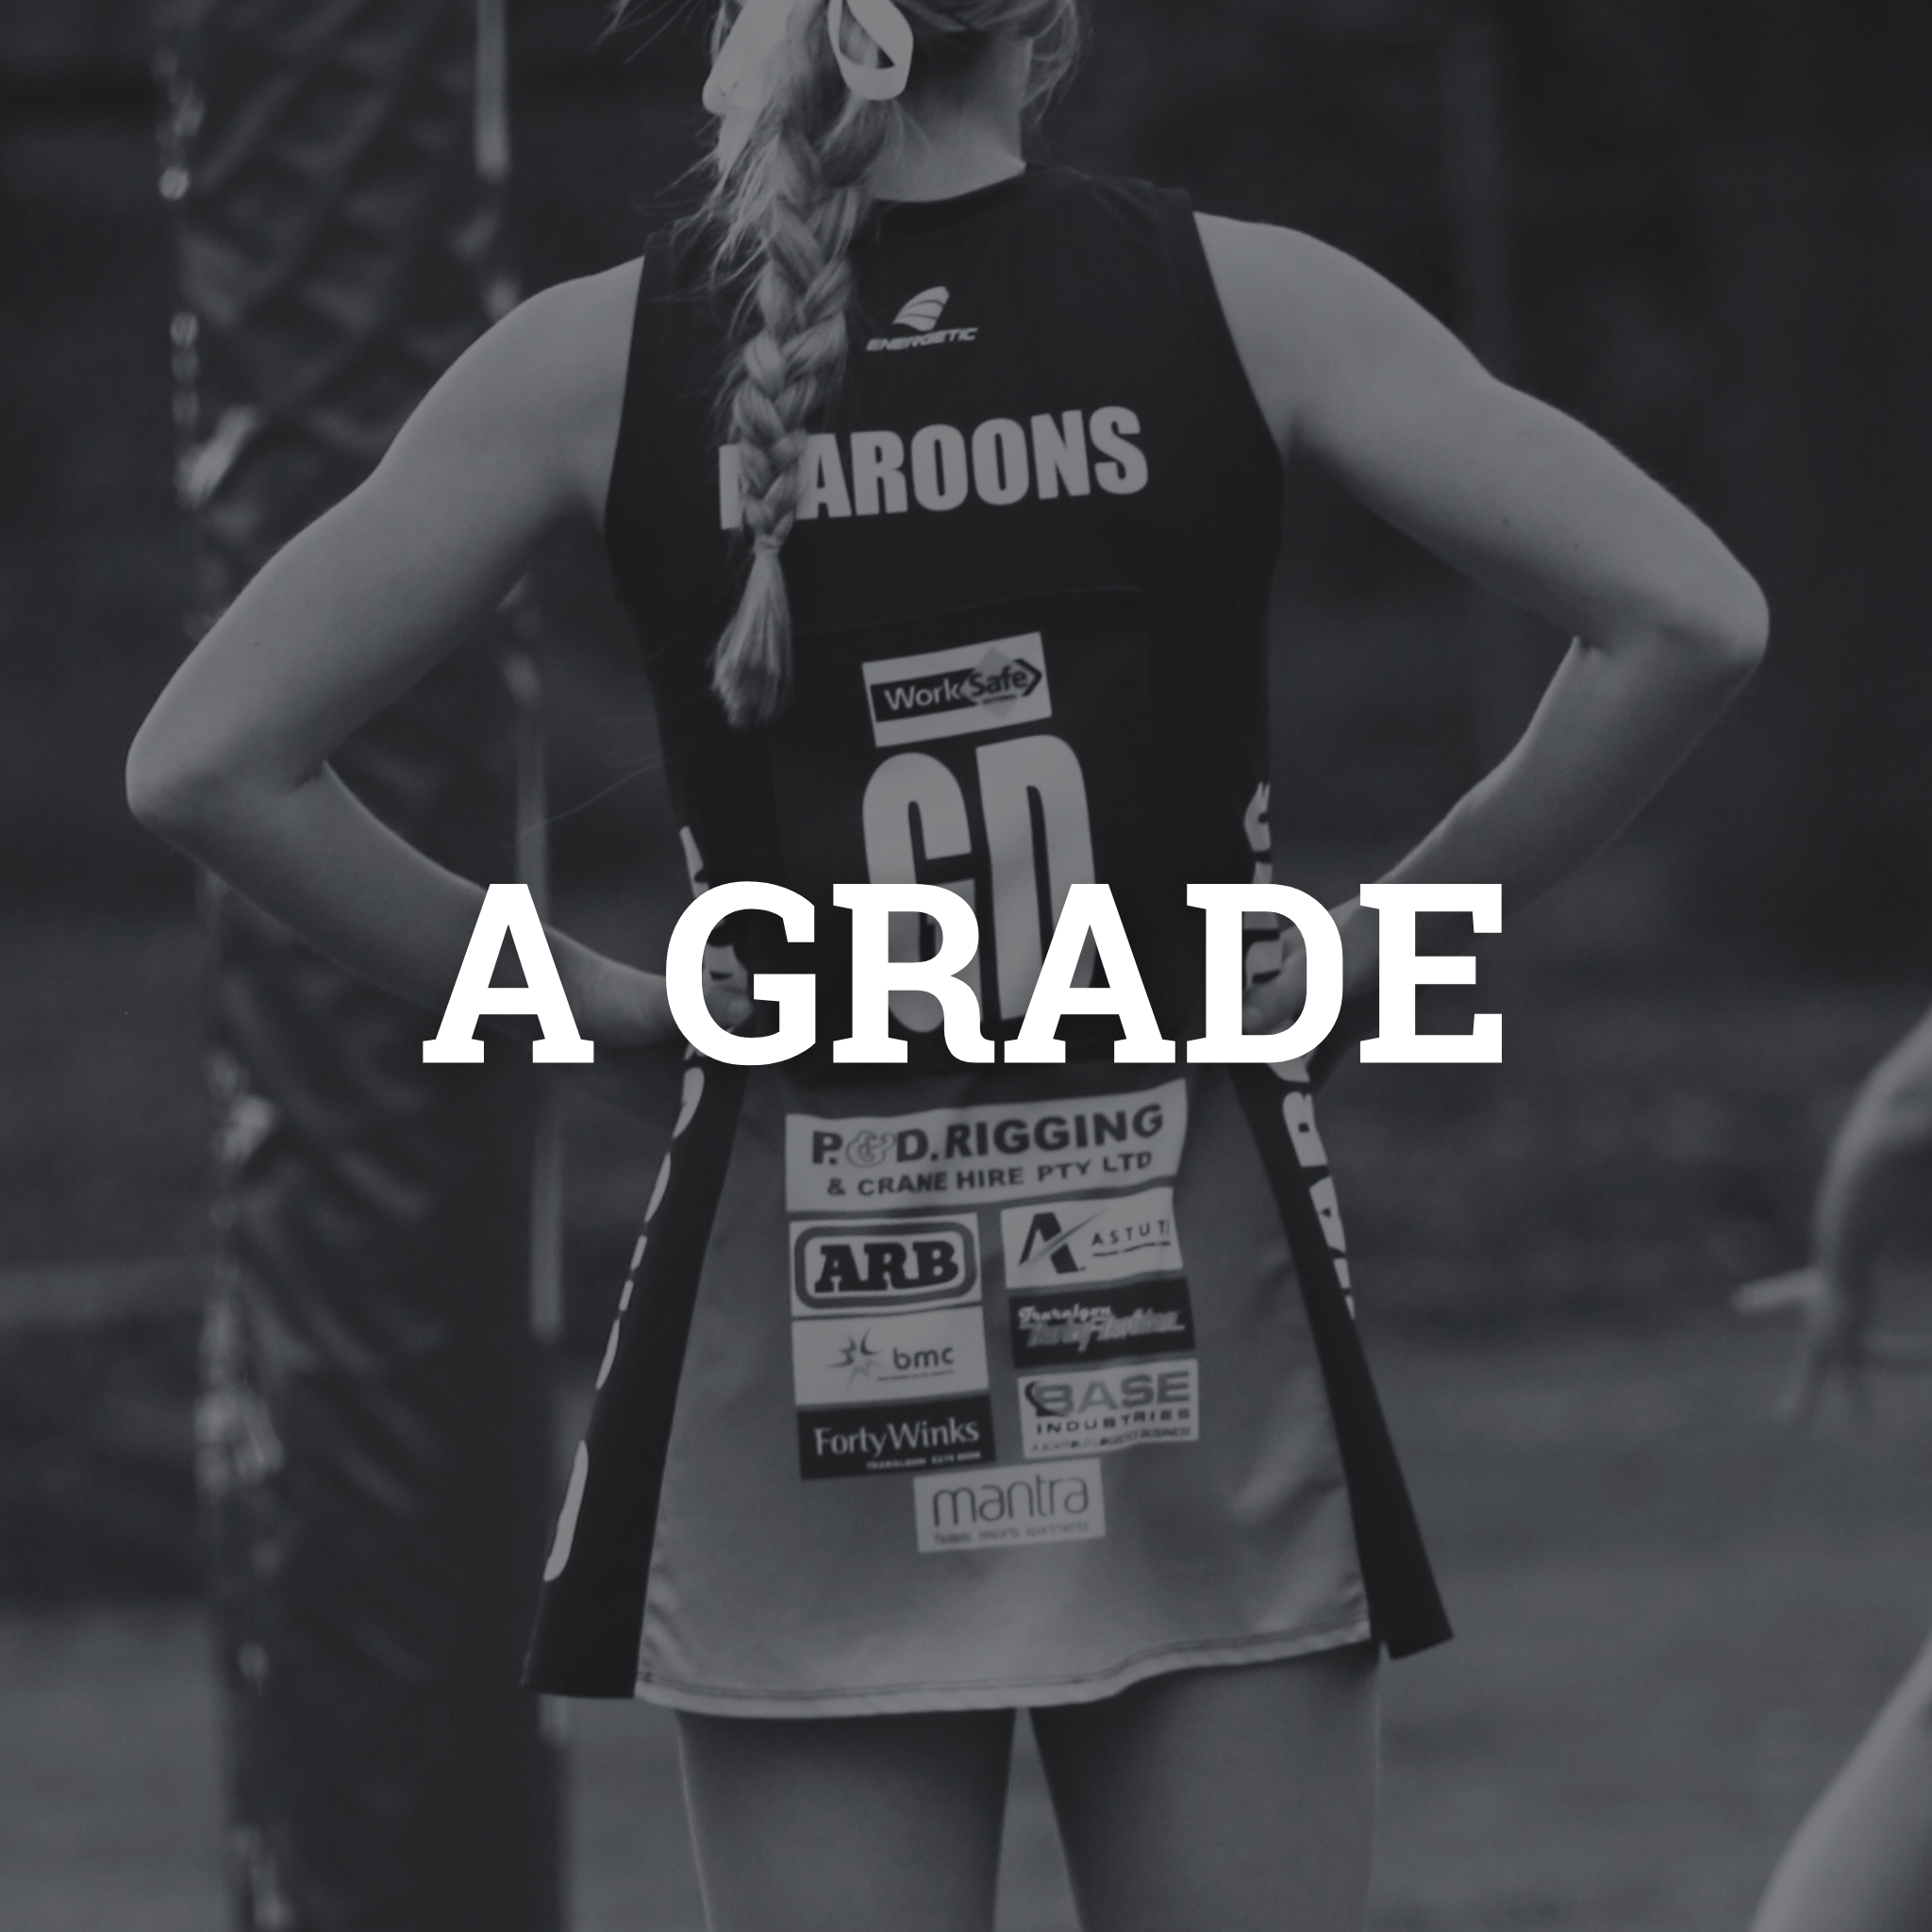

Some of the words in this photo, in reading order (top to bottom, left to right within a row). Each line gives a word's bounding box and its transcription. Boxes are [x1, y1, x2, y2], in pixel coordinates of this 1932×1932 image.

[865, 326, 979, 352] ENERGETIC
[719, 406, 1148, 529] AROONS
[827, 1177, 845, 1196] &
[858, 1172, 947, 1196] CRANE
[957, 1168, 1024, 1190] HIRE
[1038, 1160, 1091, 1181] PTY
[1103, 1152, 1152, 1173] LTD
[1091, 1219, 1170, 1247] ASTUT
[814, 1240, 959, 1293] ARB
[892, 1346, 955, 1370] bmc
[1026, 1371, 1191, 1416] BASE
[1037, 1408, 1191, 1435] INDUSTRIES
[932, 1473, 1089, 1526] mantra
